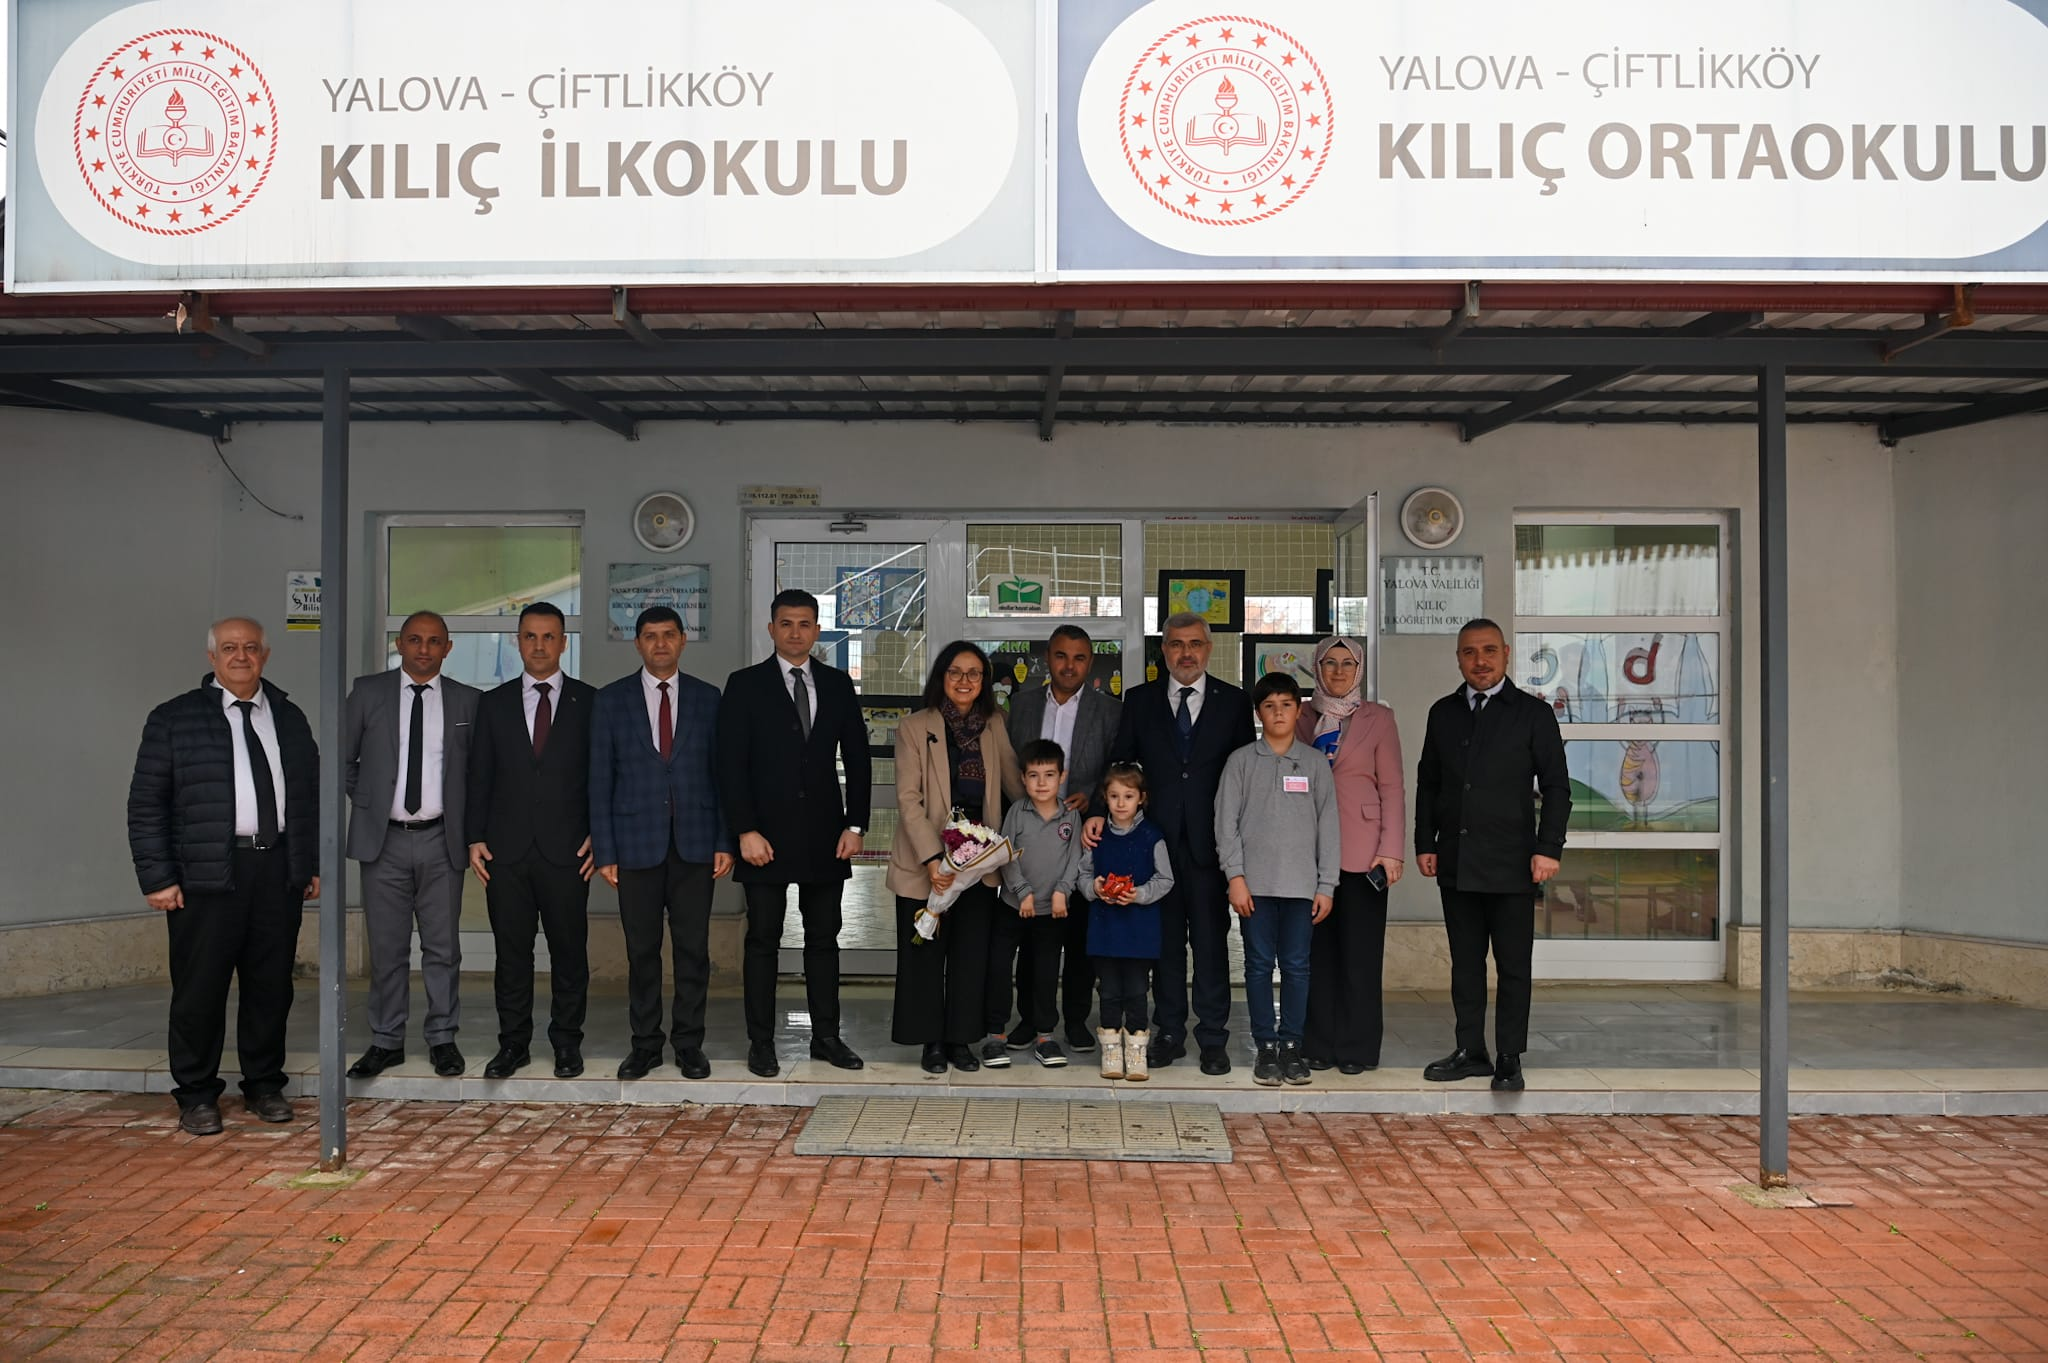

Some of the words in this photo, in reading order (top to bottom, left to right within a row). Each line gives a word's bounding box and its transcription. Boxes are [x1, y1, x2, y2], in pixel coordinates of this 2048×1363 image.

[172, 66, 210, 84] MİLLİ
[1222, 53, 1263, 72] MİLLİ
[1379, 55, 1543, 90] YALOVA
[1582, 46, 1821, 98] ÇİFTLİKKÖY
[111, 66, 168, 147] CUMHURİYETİ
[210, 81, 240, 126] EĞİTİM
[322, 76, 488, 112] YALOVA
[528, 65, 774, 119] ÇİFTLİKKÖY
[1159, 53, 1217, 135] CUMHURİYETİ
[1262, 69, 1294, 116] EĞİTİM
[116, 151, 161, 196] TÜRKİYE
[190, 131, 240, 195] BAKANLIĞI
[320, 142, 501, 215] KILIÇ
[541, 128, 908, 197] İLKOKULU
[1163, 139, 1211, 185] TÜRKİYE
[1242, 120, 1294, 184] BAKANLIĞI
[1379, 122, 1566, 196] KILIÇ
[1588, 122, 2047, 182] ORTAOKULU
[1384, 578, 1428, 589] YALOVA
[1416, 600, 1447, 611] KILIÇ
